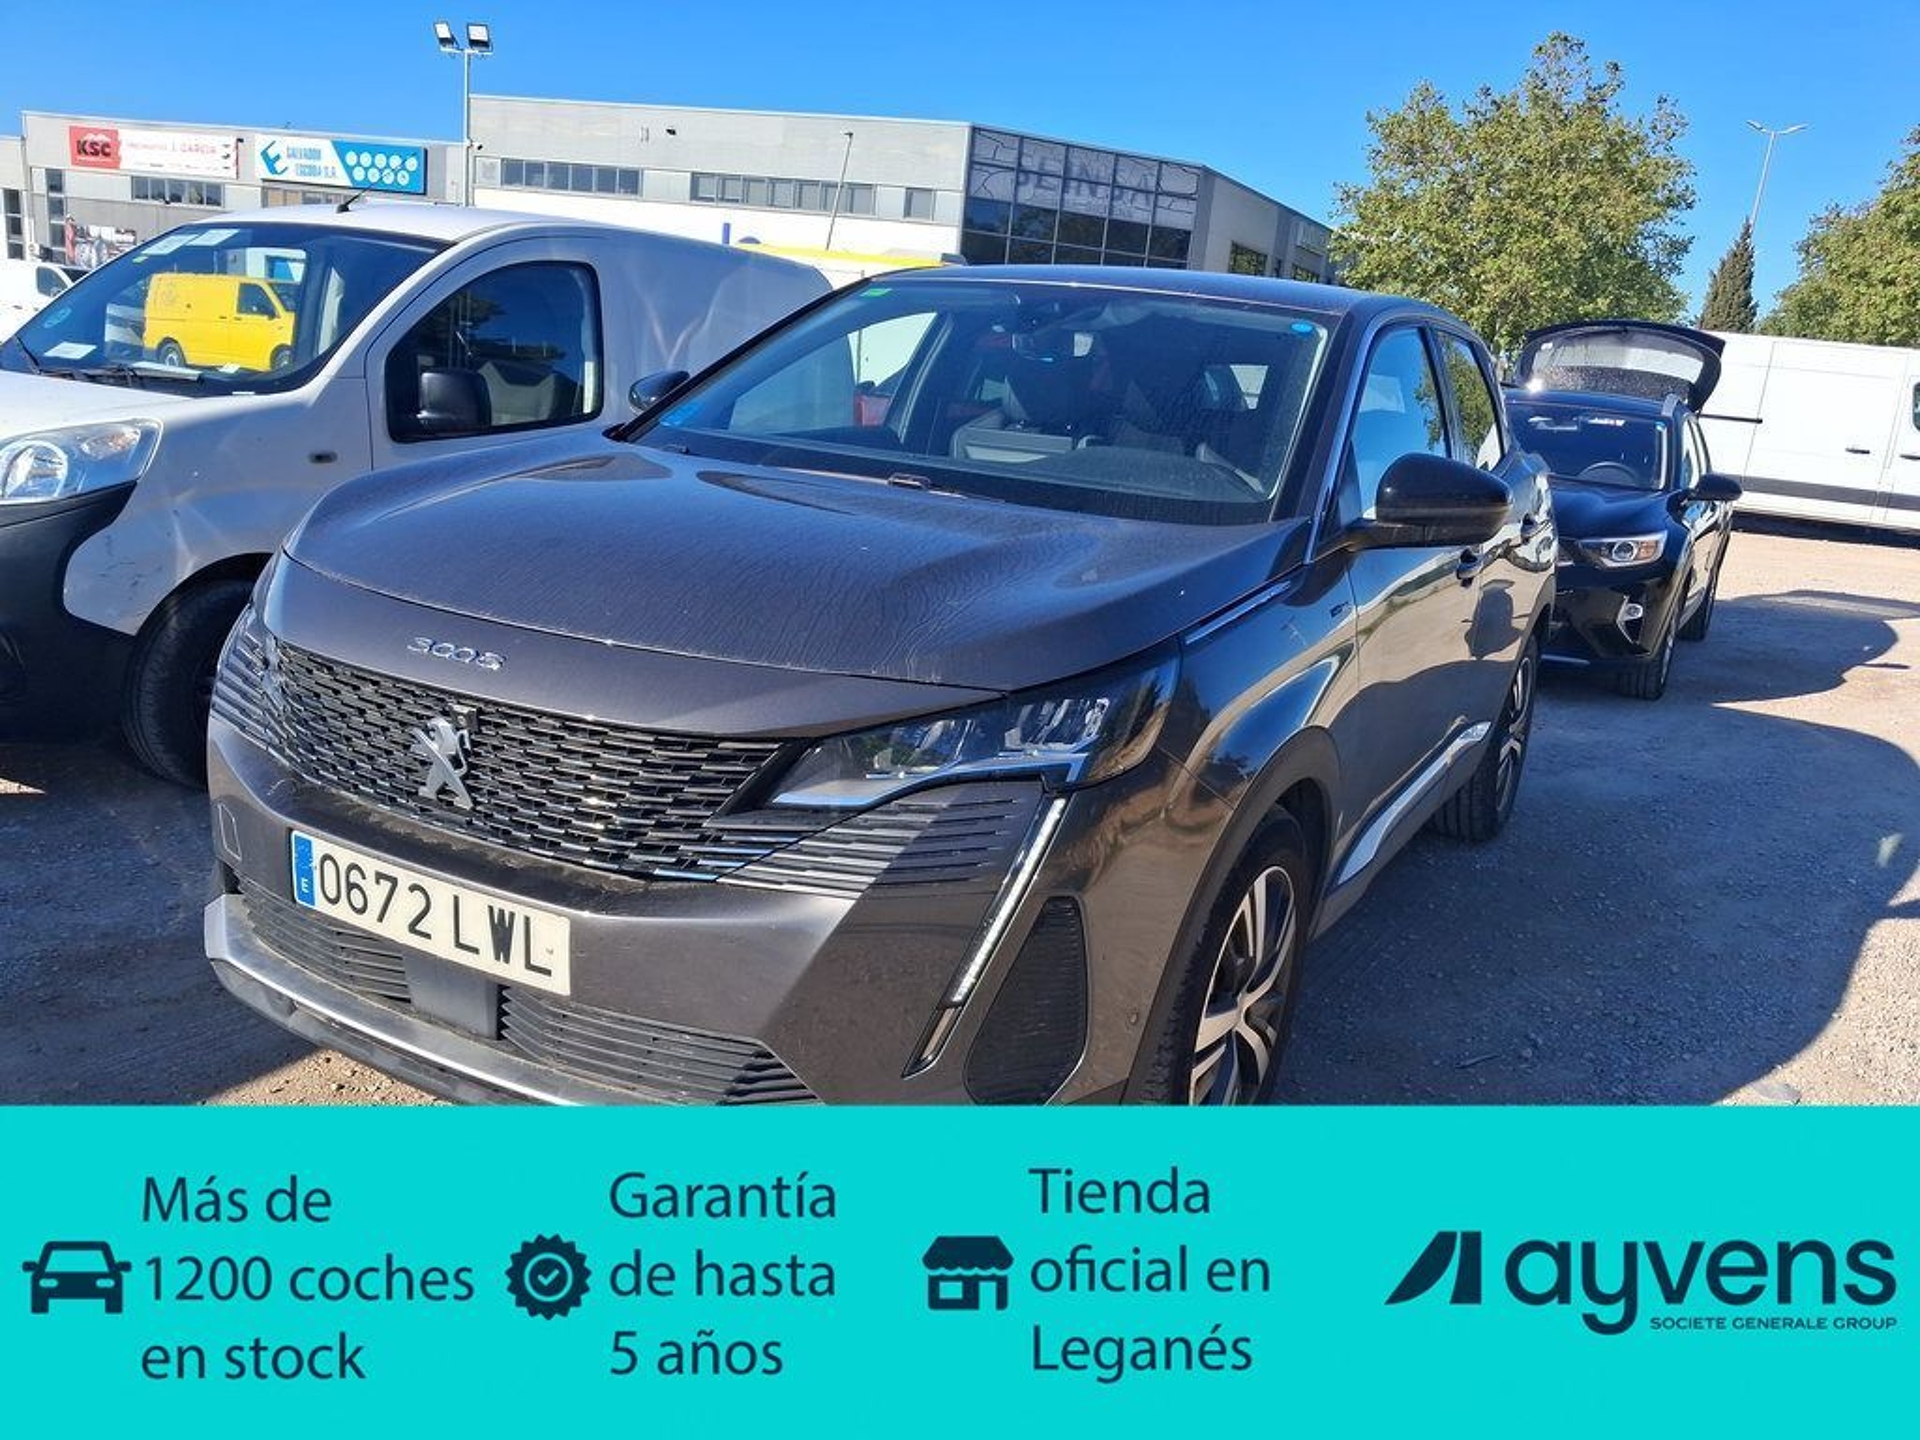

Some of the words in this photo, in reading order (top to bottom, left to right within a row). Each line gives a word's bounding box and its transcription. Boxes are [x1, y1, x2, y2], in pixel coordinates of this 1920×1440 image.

[76, 139, 112, 157] KSC
[319, 852, 432, 941] 0672
[452, 893, 553, 978] LWL
